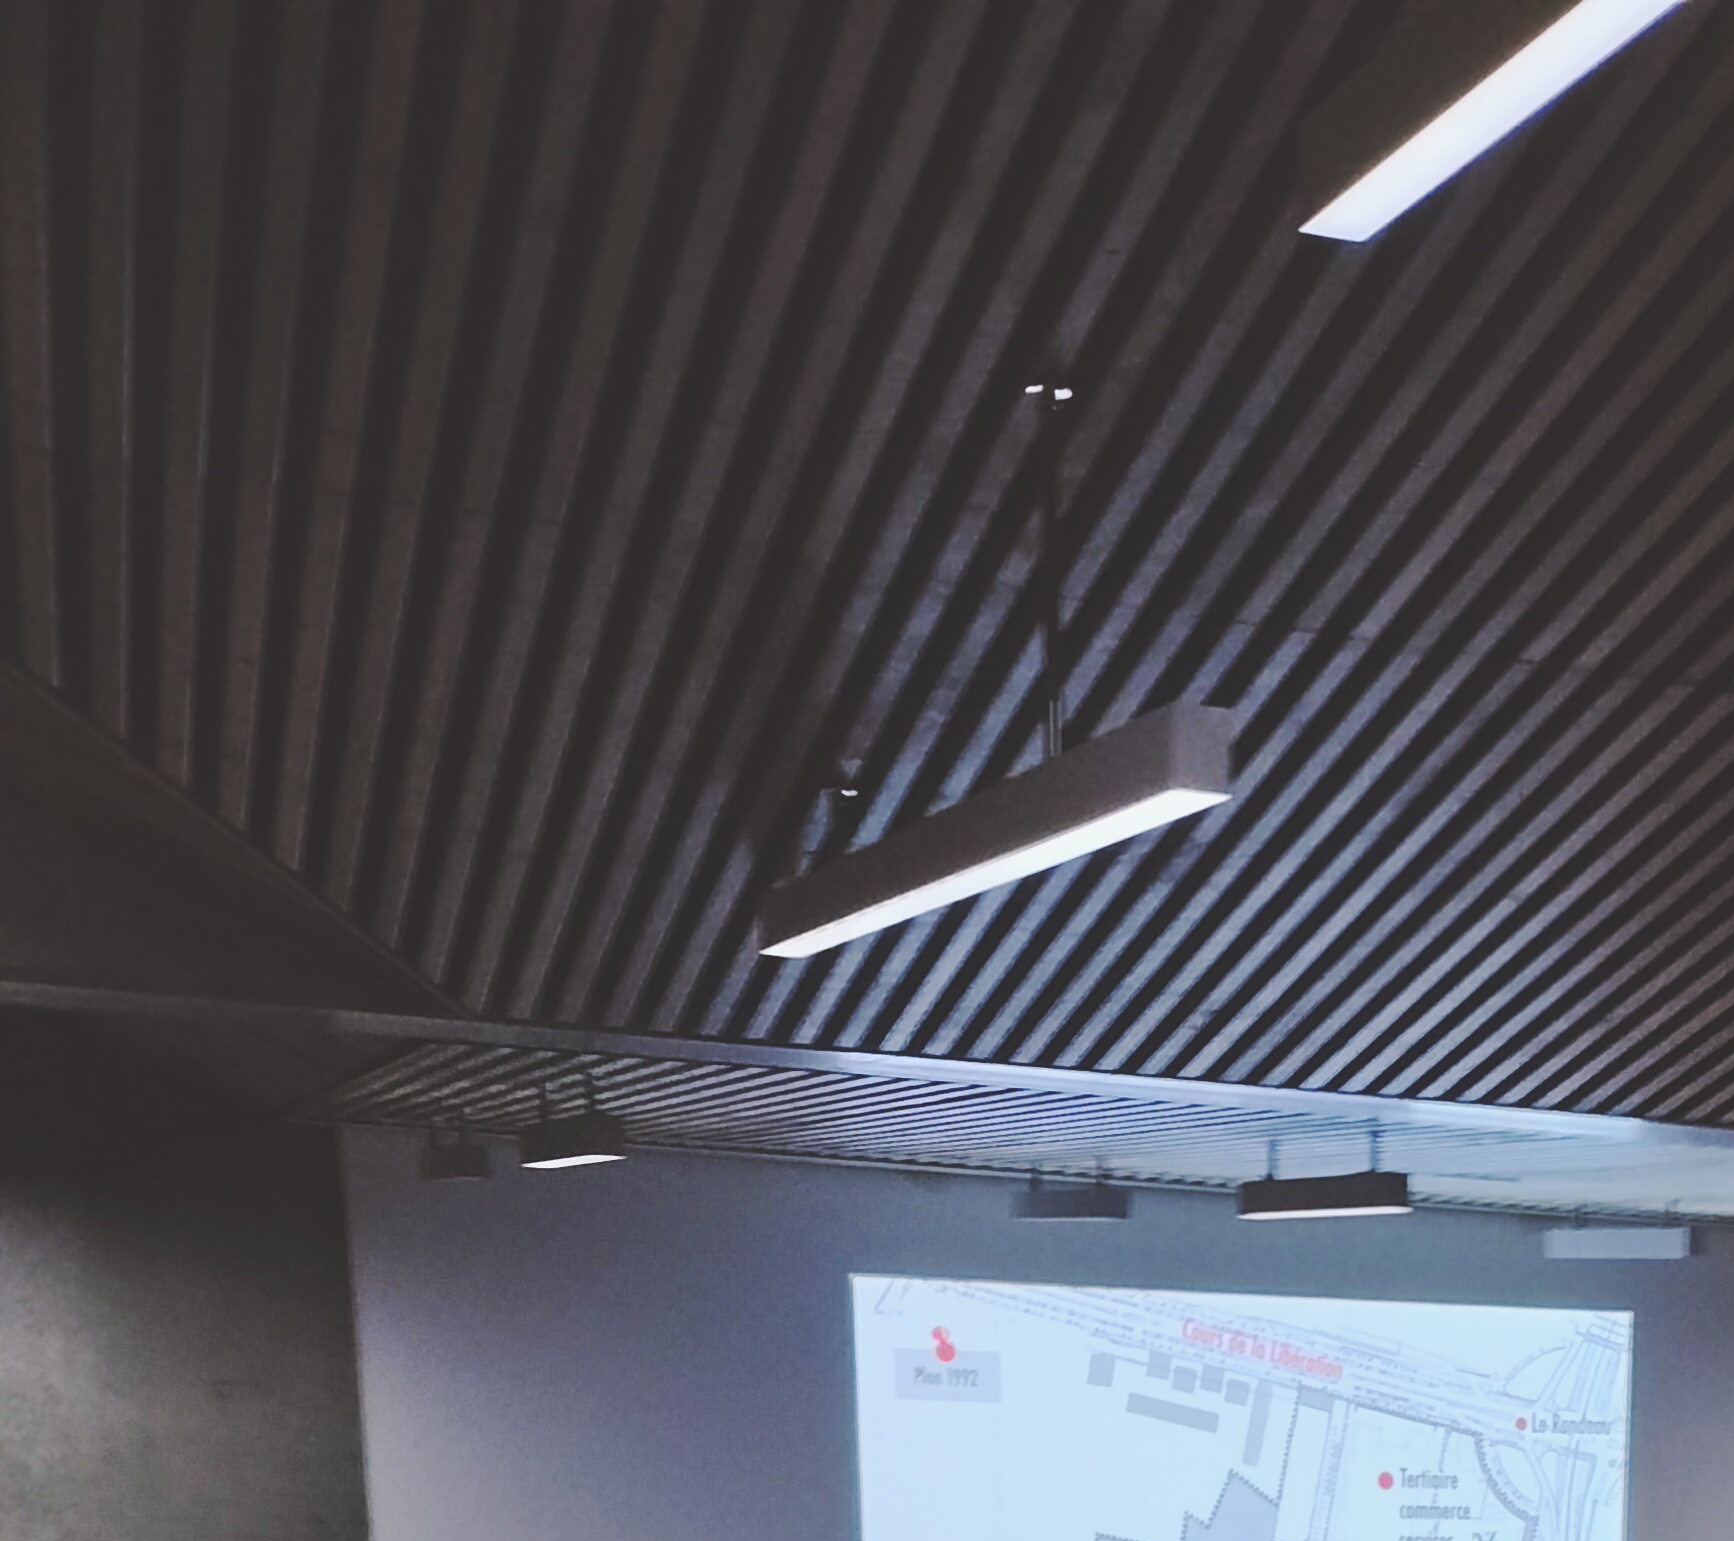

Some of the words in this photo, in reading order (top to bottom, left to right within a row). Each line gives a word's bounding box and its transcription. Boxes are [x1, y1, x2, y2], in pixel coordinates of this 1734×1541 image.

[1182, 1317, 1224, 1349] Cours
[1228, 1330, 1247, 1355] de
[1251, 1334, 1265, 1360] la
[947, 1368, 979, 1387] 1992
[1400, 1467, 1458, 1489] Tertiaire
[1400, 1505, 1471, 1520] commerce
